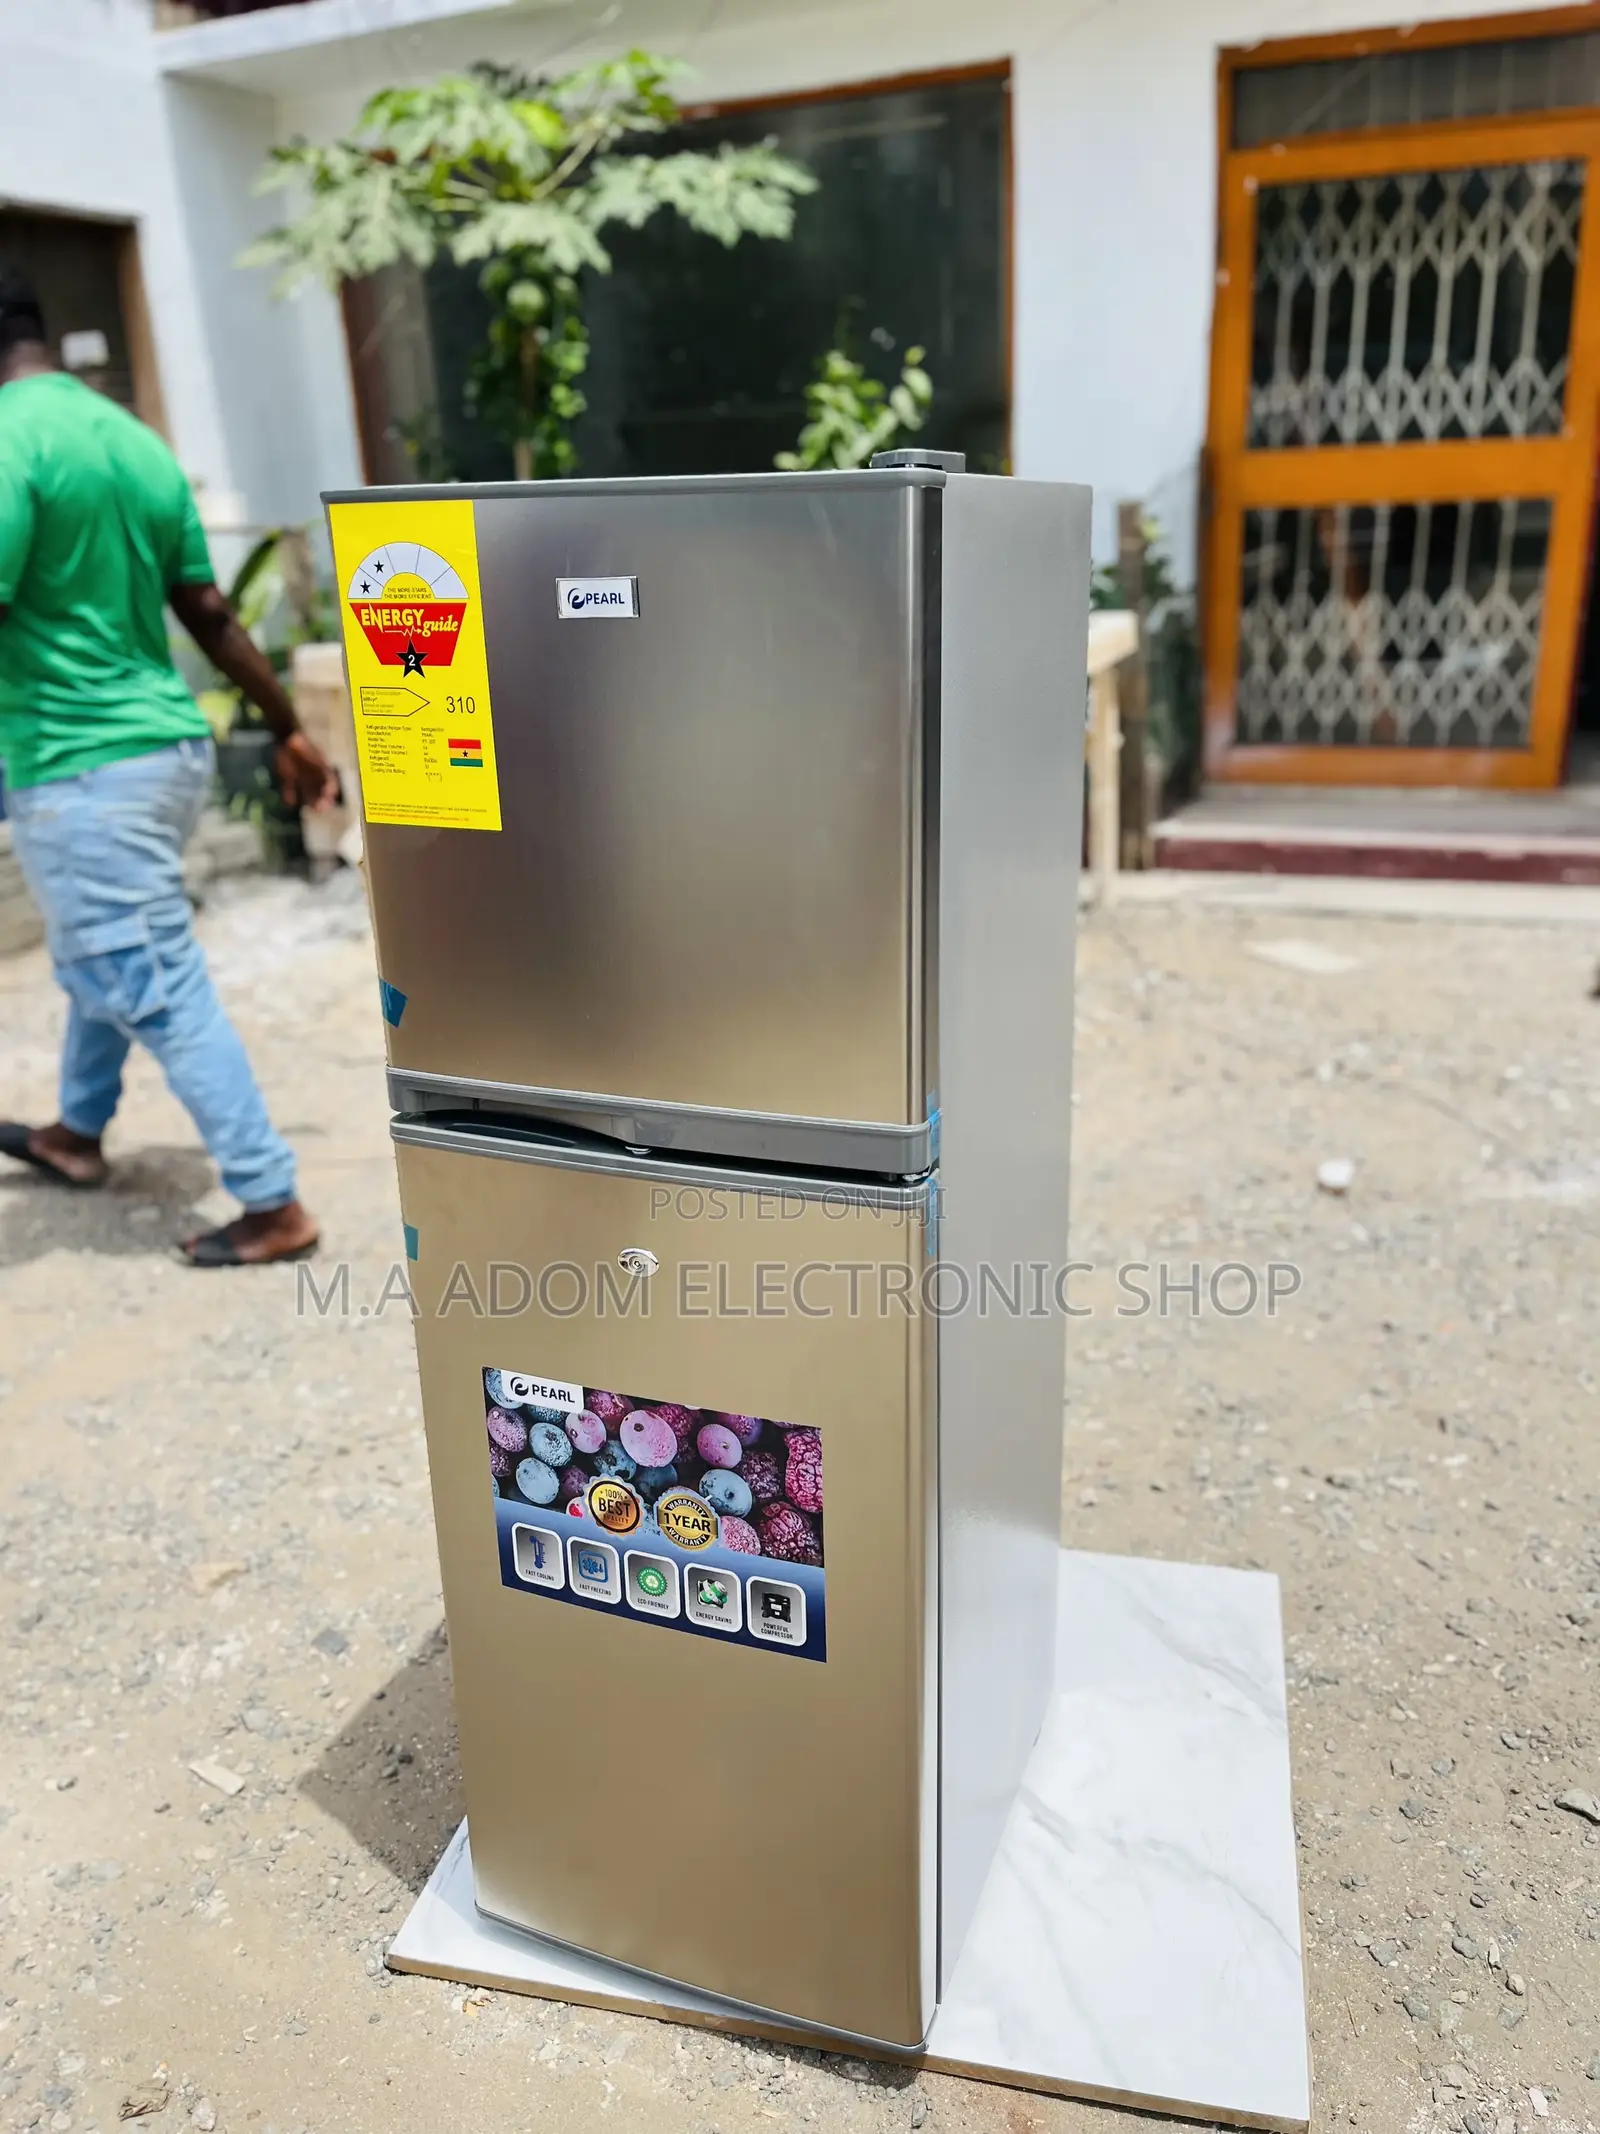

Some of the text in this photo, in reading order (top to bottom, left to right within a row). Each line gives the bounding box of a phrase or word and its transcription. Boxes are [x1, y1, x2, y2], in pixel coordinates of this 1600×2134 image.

[585, 592, 625, 605] PEARL
[361, 604, 459, 638] ENERGY guide
[408, 654, 416, 666] 2
[445, 696, 476, 714] 310
[531, 1384, 576, 1404] PEARL
[604, 1487, 624, 1501] 100%
[598, 1497, 631, 1518] BEST
[667, 1498, 707, 1517] WARRANTY
[668, 1527, 708, 1546] WARRANTY
[525, 1568, 555, 1582] FAST COOLING
[579, 1583, 612, 1596] FAST FREEZING
[695, 1611, 733, 1624] ENERGY SAVING
[760, 1628, 794, 1640] COMPRESSOR
[763, 1622, 789, 1633] POWERFUL
